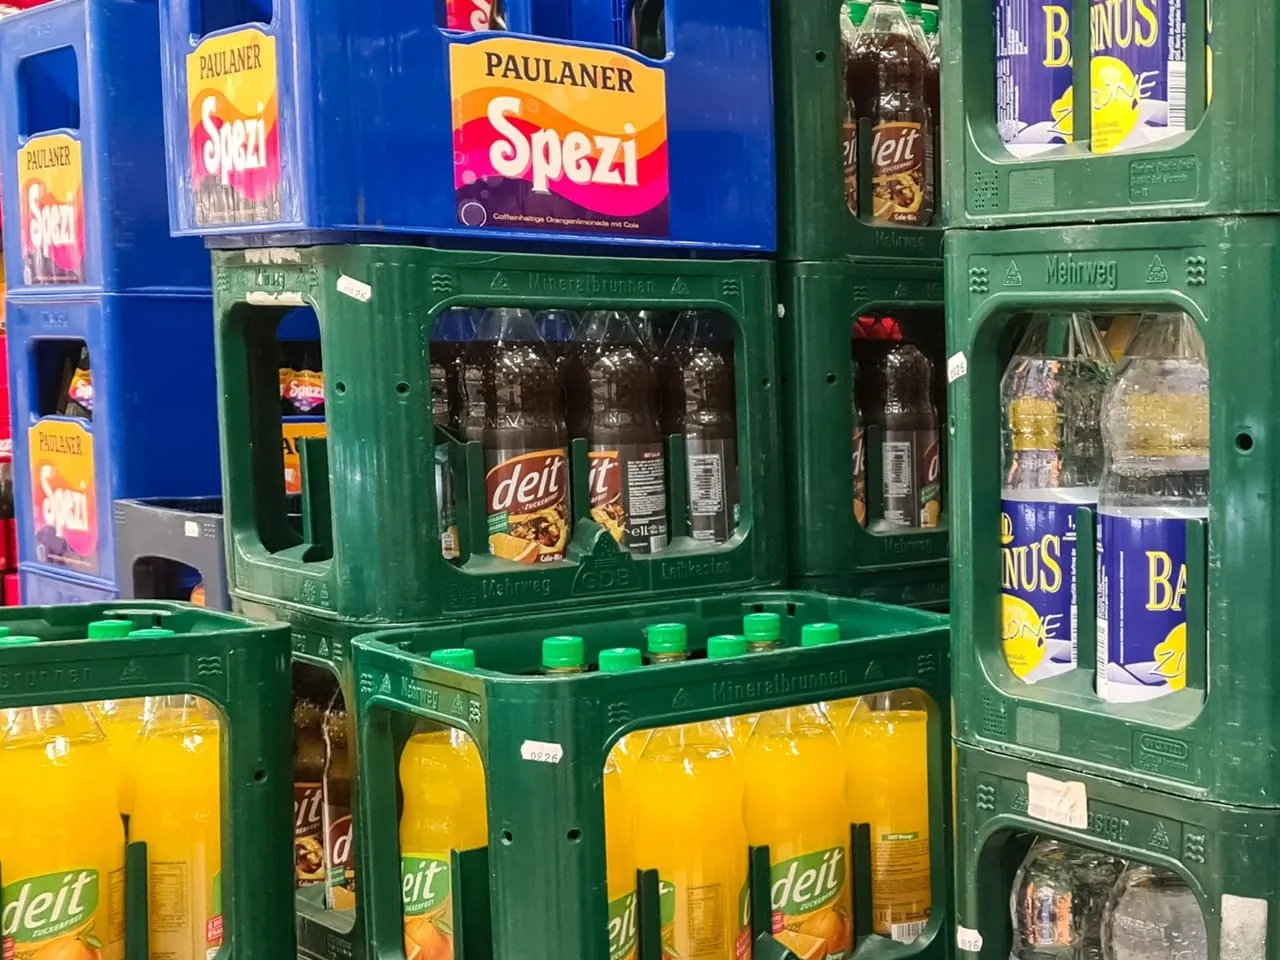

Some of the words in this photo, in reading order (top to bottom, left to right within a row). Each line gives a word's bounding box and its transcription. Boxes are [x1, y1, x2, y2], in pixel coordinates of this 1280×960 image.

[199, 44, 262, 80] PAULANER
[484, 51, 636, 94] PAULANER
[27, 146, 71, 171] PAULANER
[201, 96, 266, 185] Spezi
[487, 96, 639, 195] Spezi
[28, 183, 76, 258] Spezi
[623, 220, 640, 229] Cola
[528, 271, 655, 295] Mineralbrunnen
[1046, 254, 1118, 290] Mehrweg
[38, 432, 83, 456] PAULANER
[40, 463, 89, 536] Spezi
[492, 456, 564, 511] deit
[713, 667, 848, 702] Mineralbrunnen
[402, 860, 448, 904] eit
[771, 848, 844, 913] deit
[1, 870, 97, 936] deit
